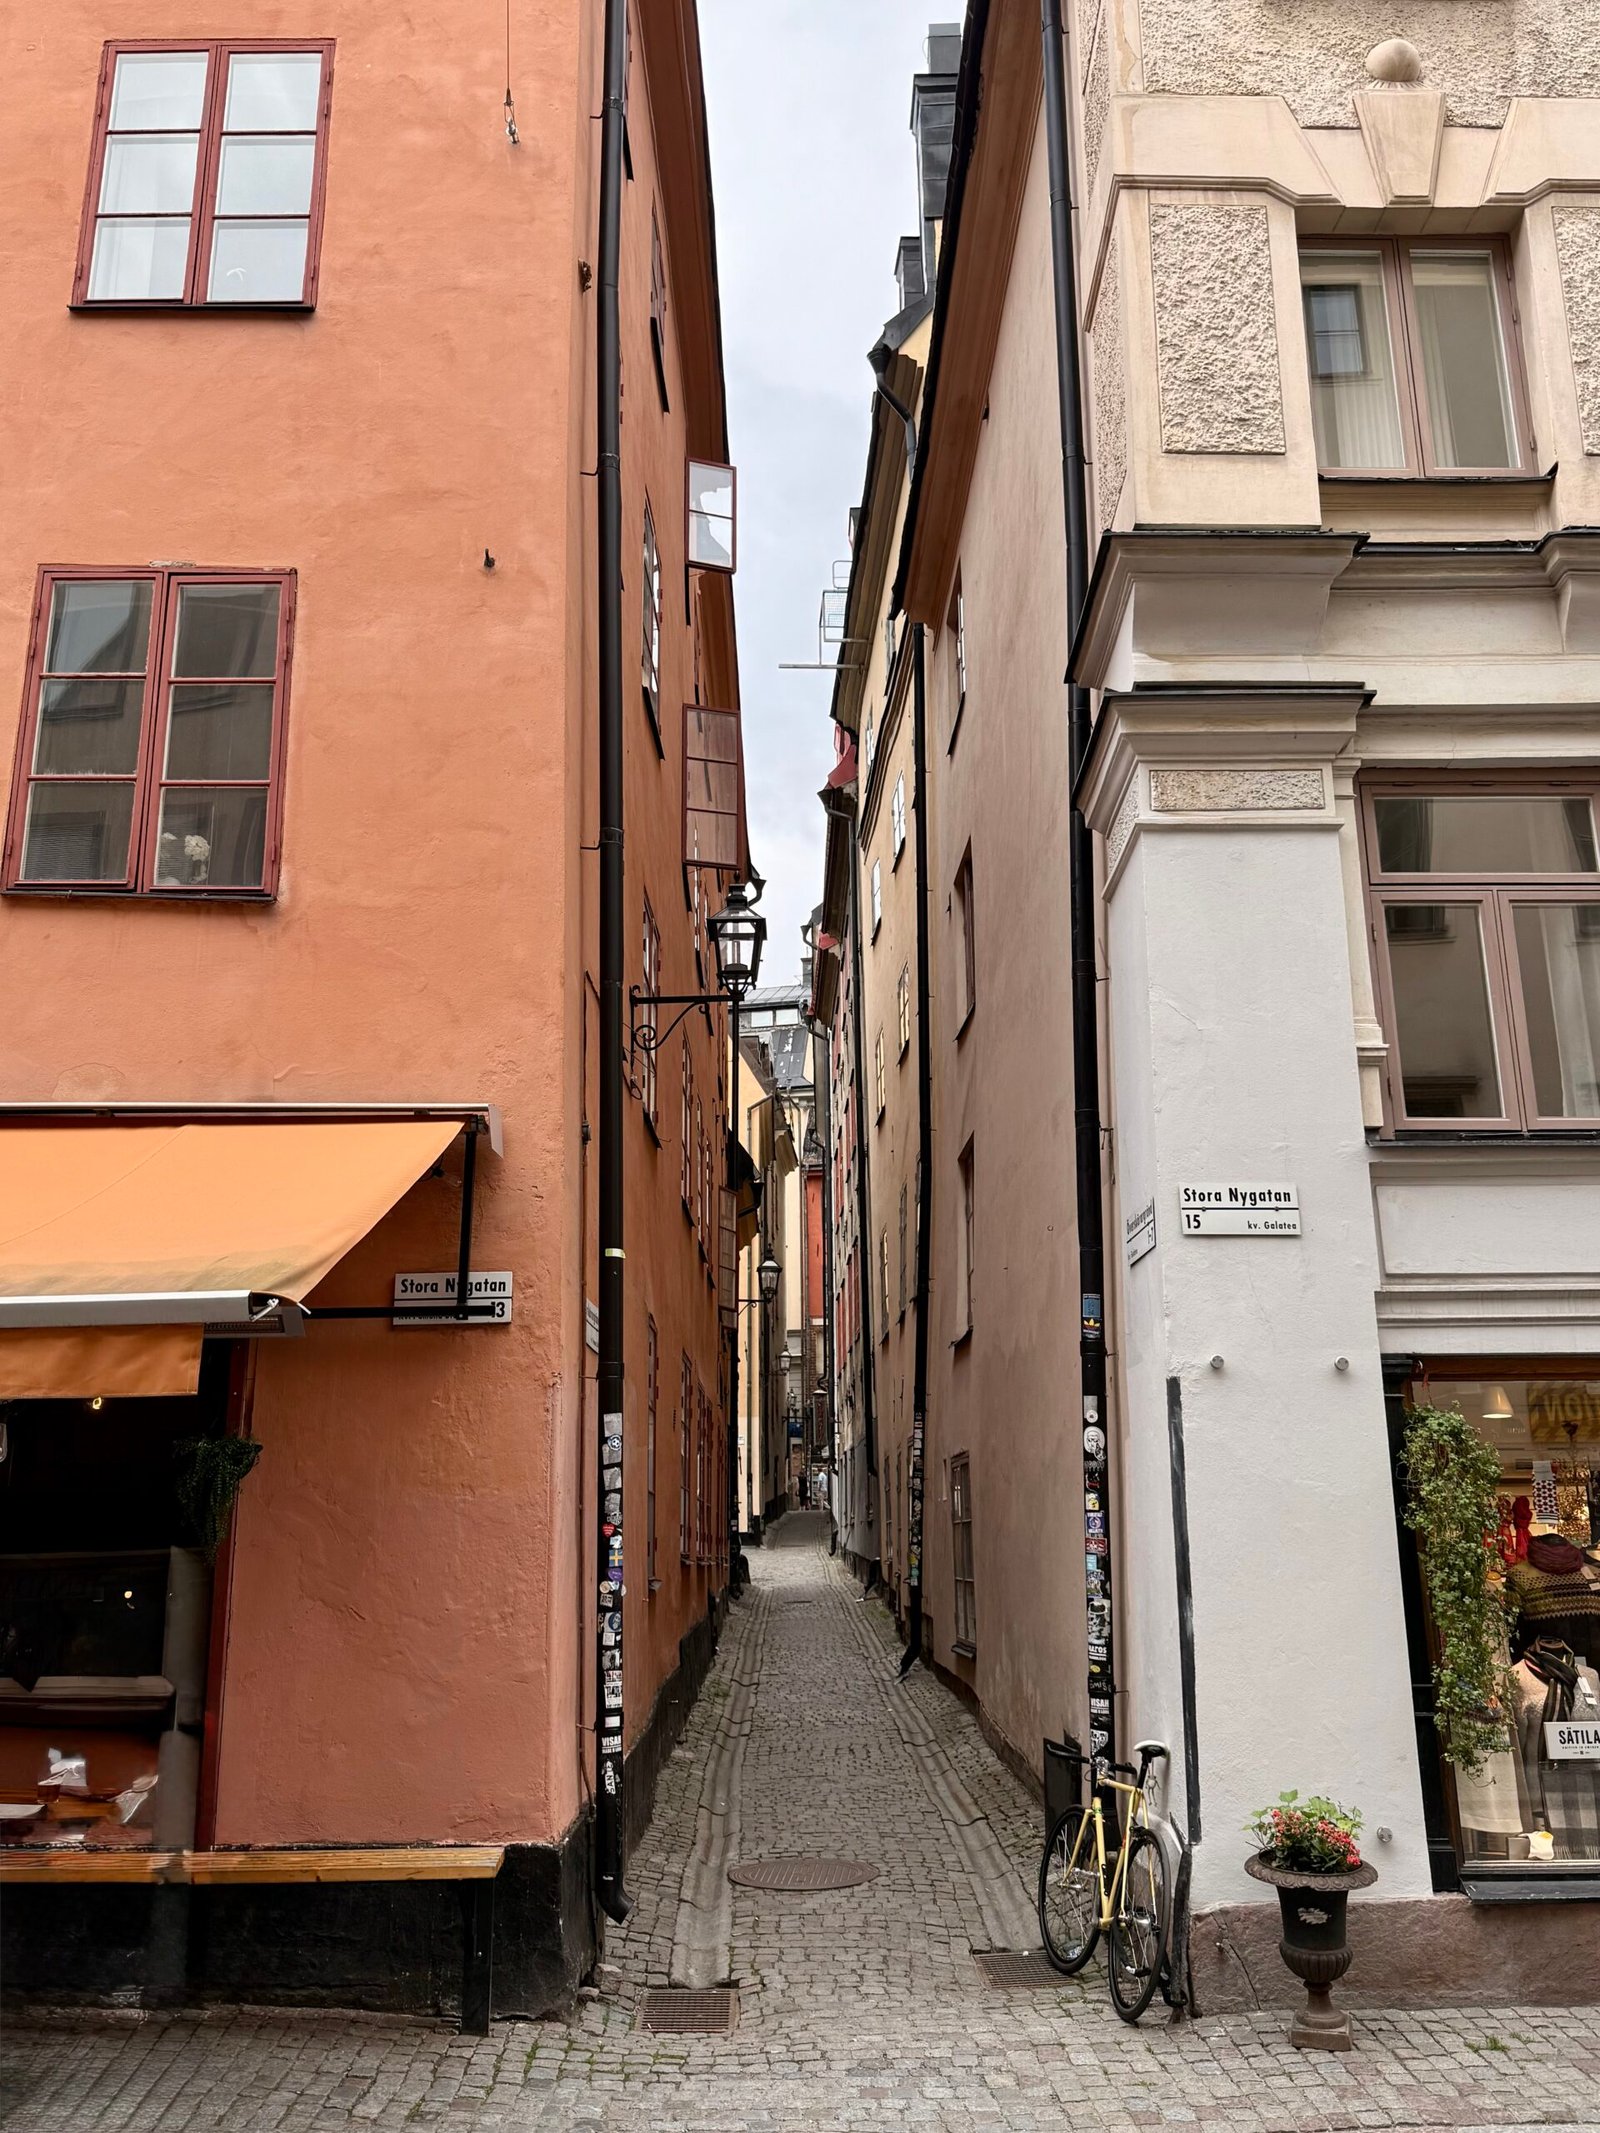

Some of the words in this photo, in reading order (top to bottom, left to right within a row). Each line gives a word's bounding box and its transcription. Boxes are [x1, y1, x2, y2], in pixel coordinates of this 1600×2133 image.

[1183, 1187, 1222, 1203] Stora
[1228, 1187, 1292, 1206] Nygatan
[1185, 1214, 1201, 1229] 15
[1247, 1220, 1261, 1230] kv.
[1264, 1220, 1298, 1230] Galatea
[400, 1278, 439, 1294] Stora
[445, 1277, 506, 1297] Ngatan
[1558, 1726, 1600, 1744] SÄTILA
